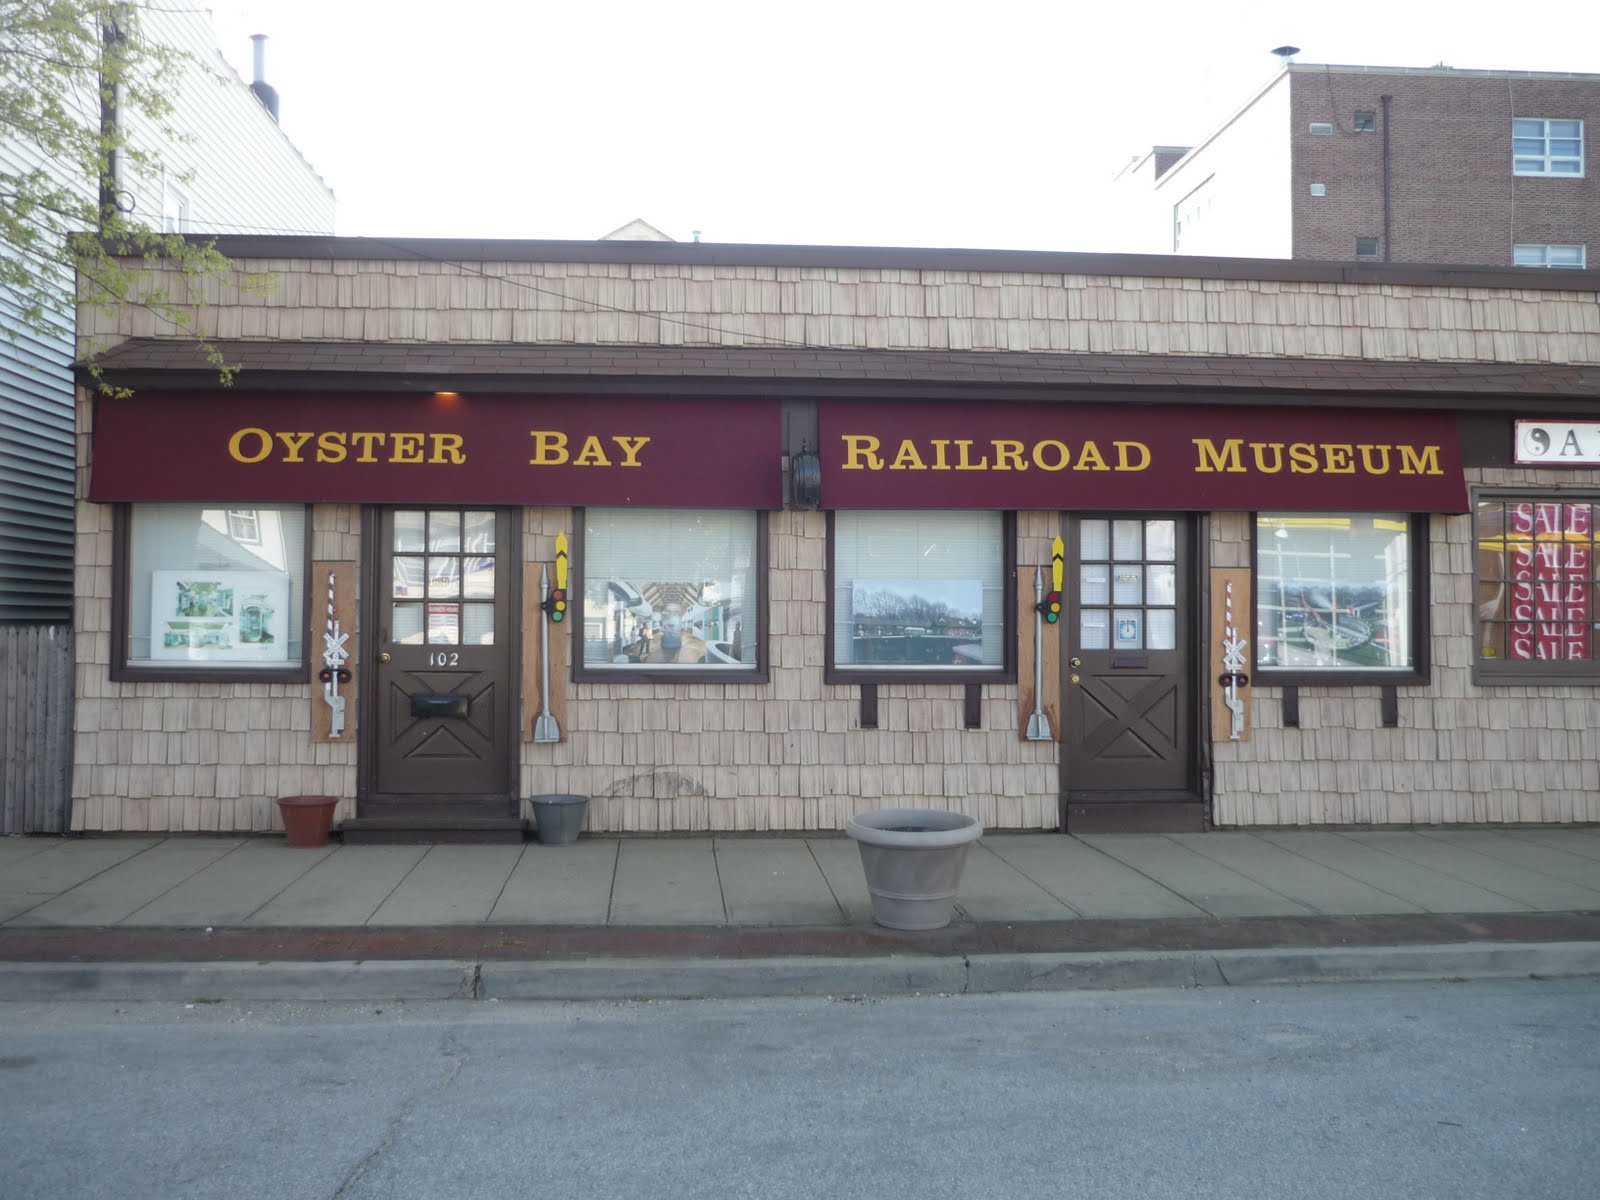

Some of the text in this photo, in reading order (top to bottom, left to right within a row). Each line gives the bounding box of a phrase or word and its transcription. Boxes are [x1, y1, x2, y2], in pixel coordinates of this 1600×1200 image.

[228, 427, 651, 468] OYSTER BAY
[841, 434, 1444, 476] RAILROAD MUSEUM
[1515, 504, 1587, 534] SALE
[1515, 541, 1586, 569] SALE
[1514, 571, 1585, 603] SALE
[1514, 605, 1585, 637] SALE
[430, 652, 459, 667] 102
[1514, 639, 1584, 660] SALE
